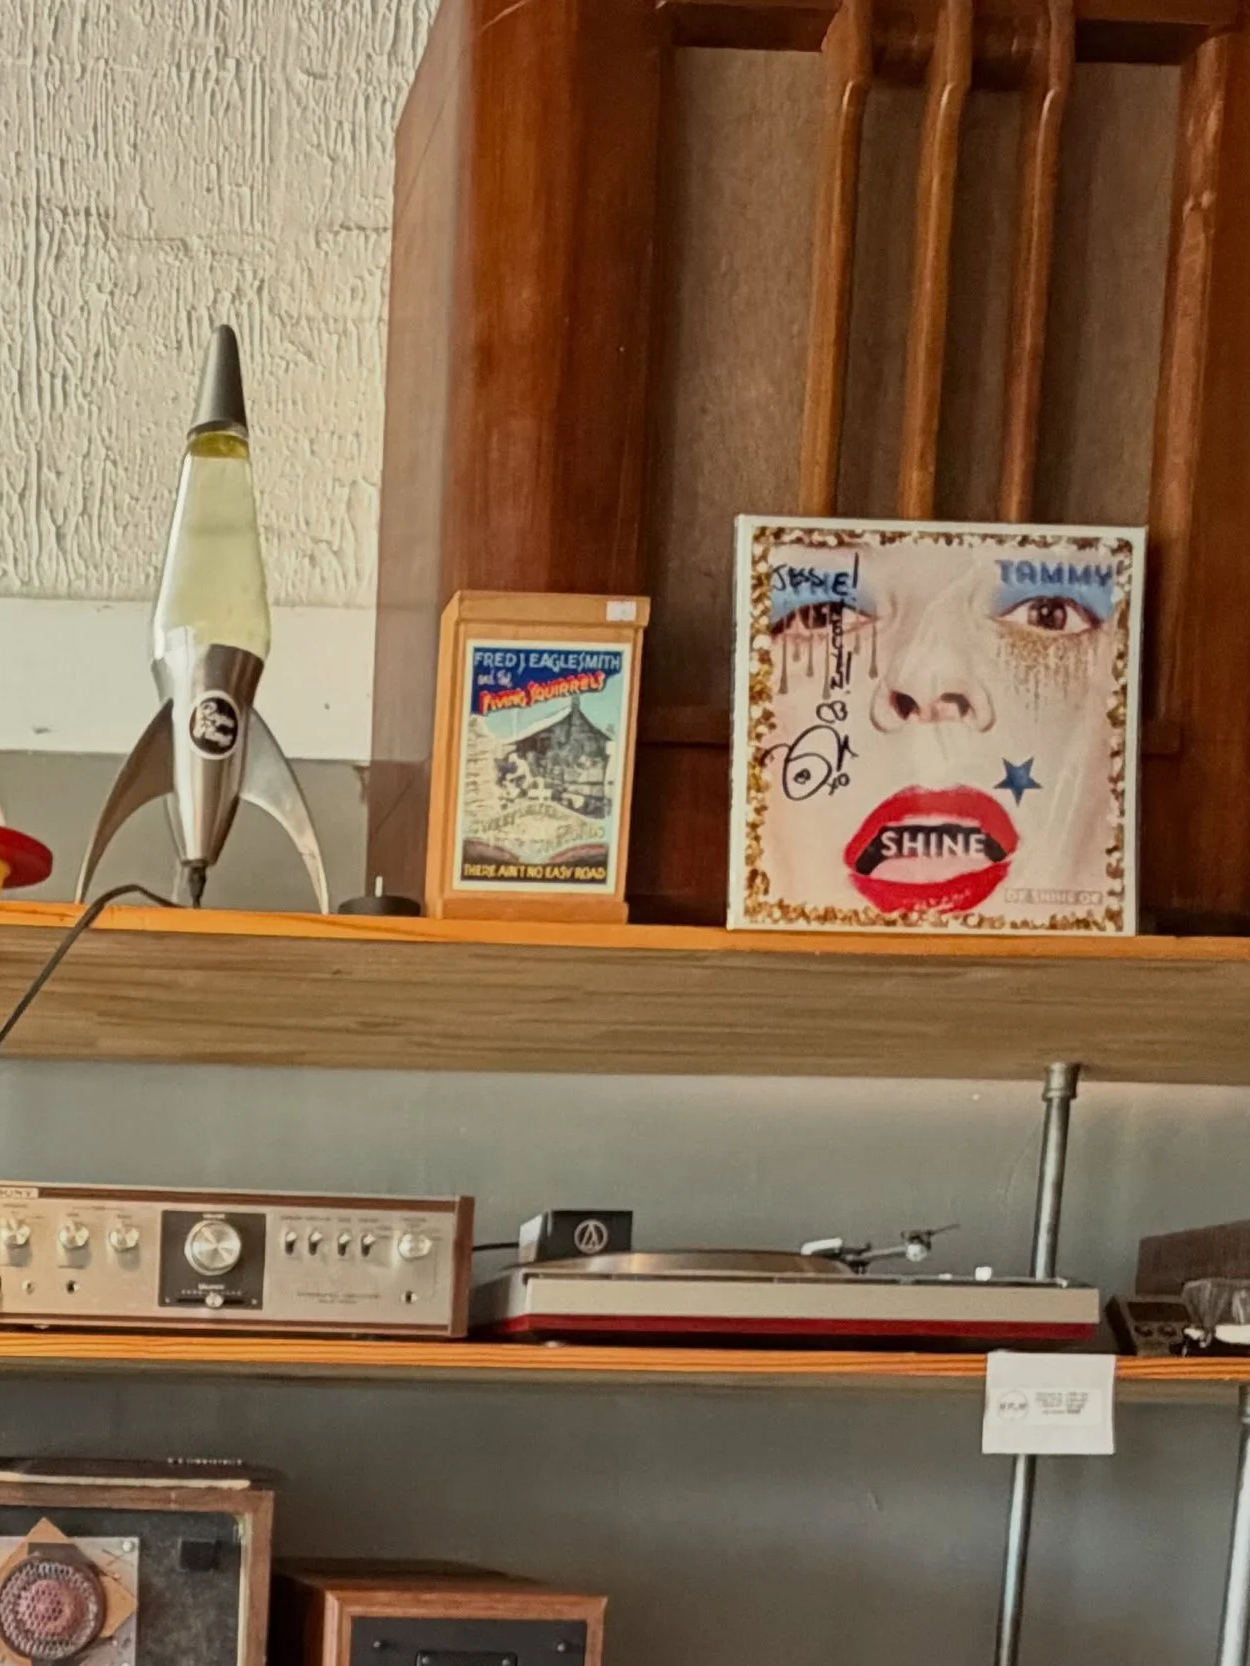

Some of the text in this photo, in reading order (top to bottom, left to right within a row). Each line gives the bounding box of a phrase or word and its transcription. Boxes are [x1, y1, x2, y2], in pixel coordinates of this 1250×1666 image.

[994, 560, 1112, 588] TAMMY
[474, 652, 517, 668] FRED
[529, 652, 621, 673] EAGLESMITH
[881, 831, 986, 857] SHINE
